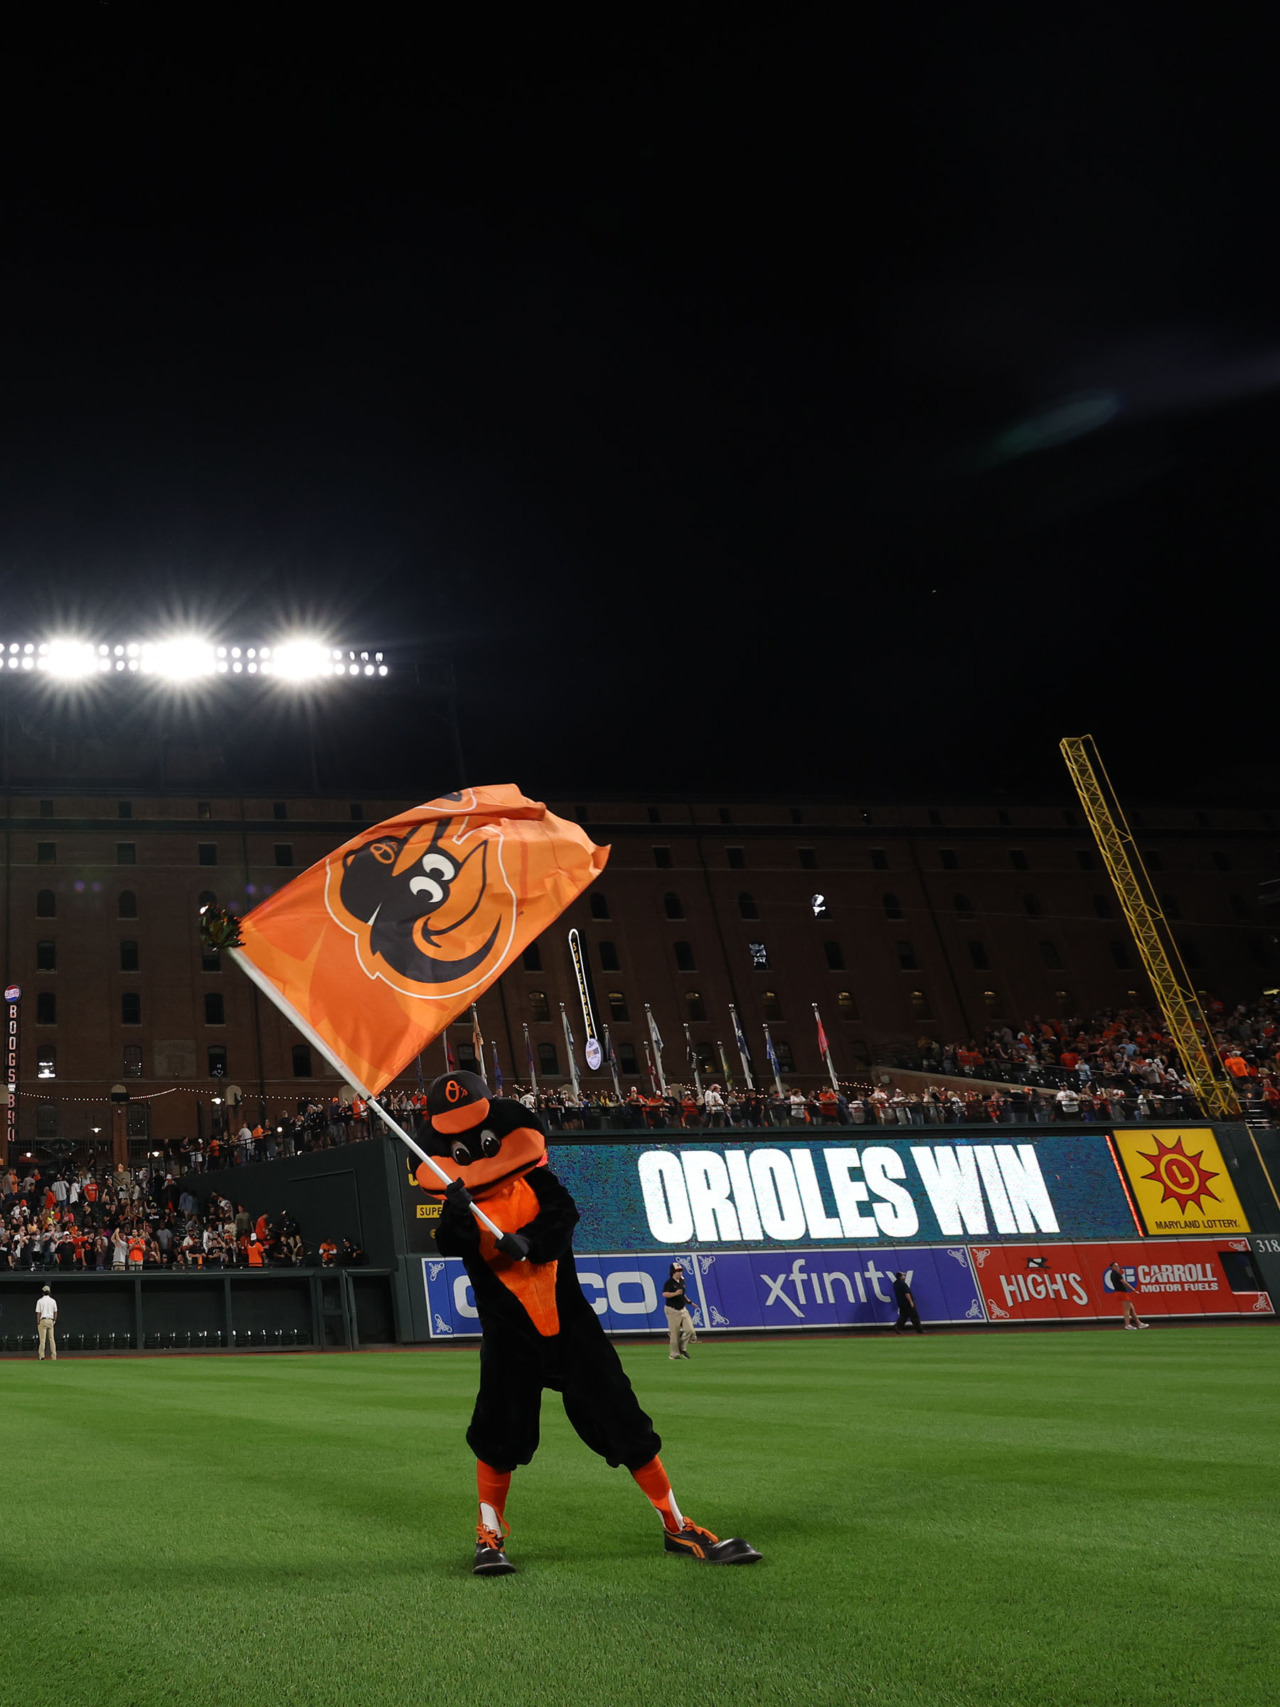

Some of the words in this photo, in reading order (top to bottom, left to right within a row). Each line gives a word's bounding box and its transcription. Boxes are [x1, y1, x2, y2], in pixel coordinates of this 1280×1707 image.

[8, 1005, 17, 1082] BOOGS
[637, 1146, 920, 1243] ORIOLES
[910, 1144, 1061, 1236] WIN
[1155, 1220, 1200, 1229] MARYLAND
[1255, 1239, 1280, 1253] 318
[1137, 1263, 1218, 1284] CARROLL
[999, 1273, 1089, 1307] HIGH'S
[1141, 1283, 1181, 1292] MOTOR
[1184, 1282, 1219, 1292] FUELS
